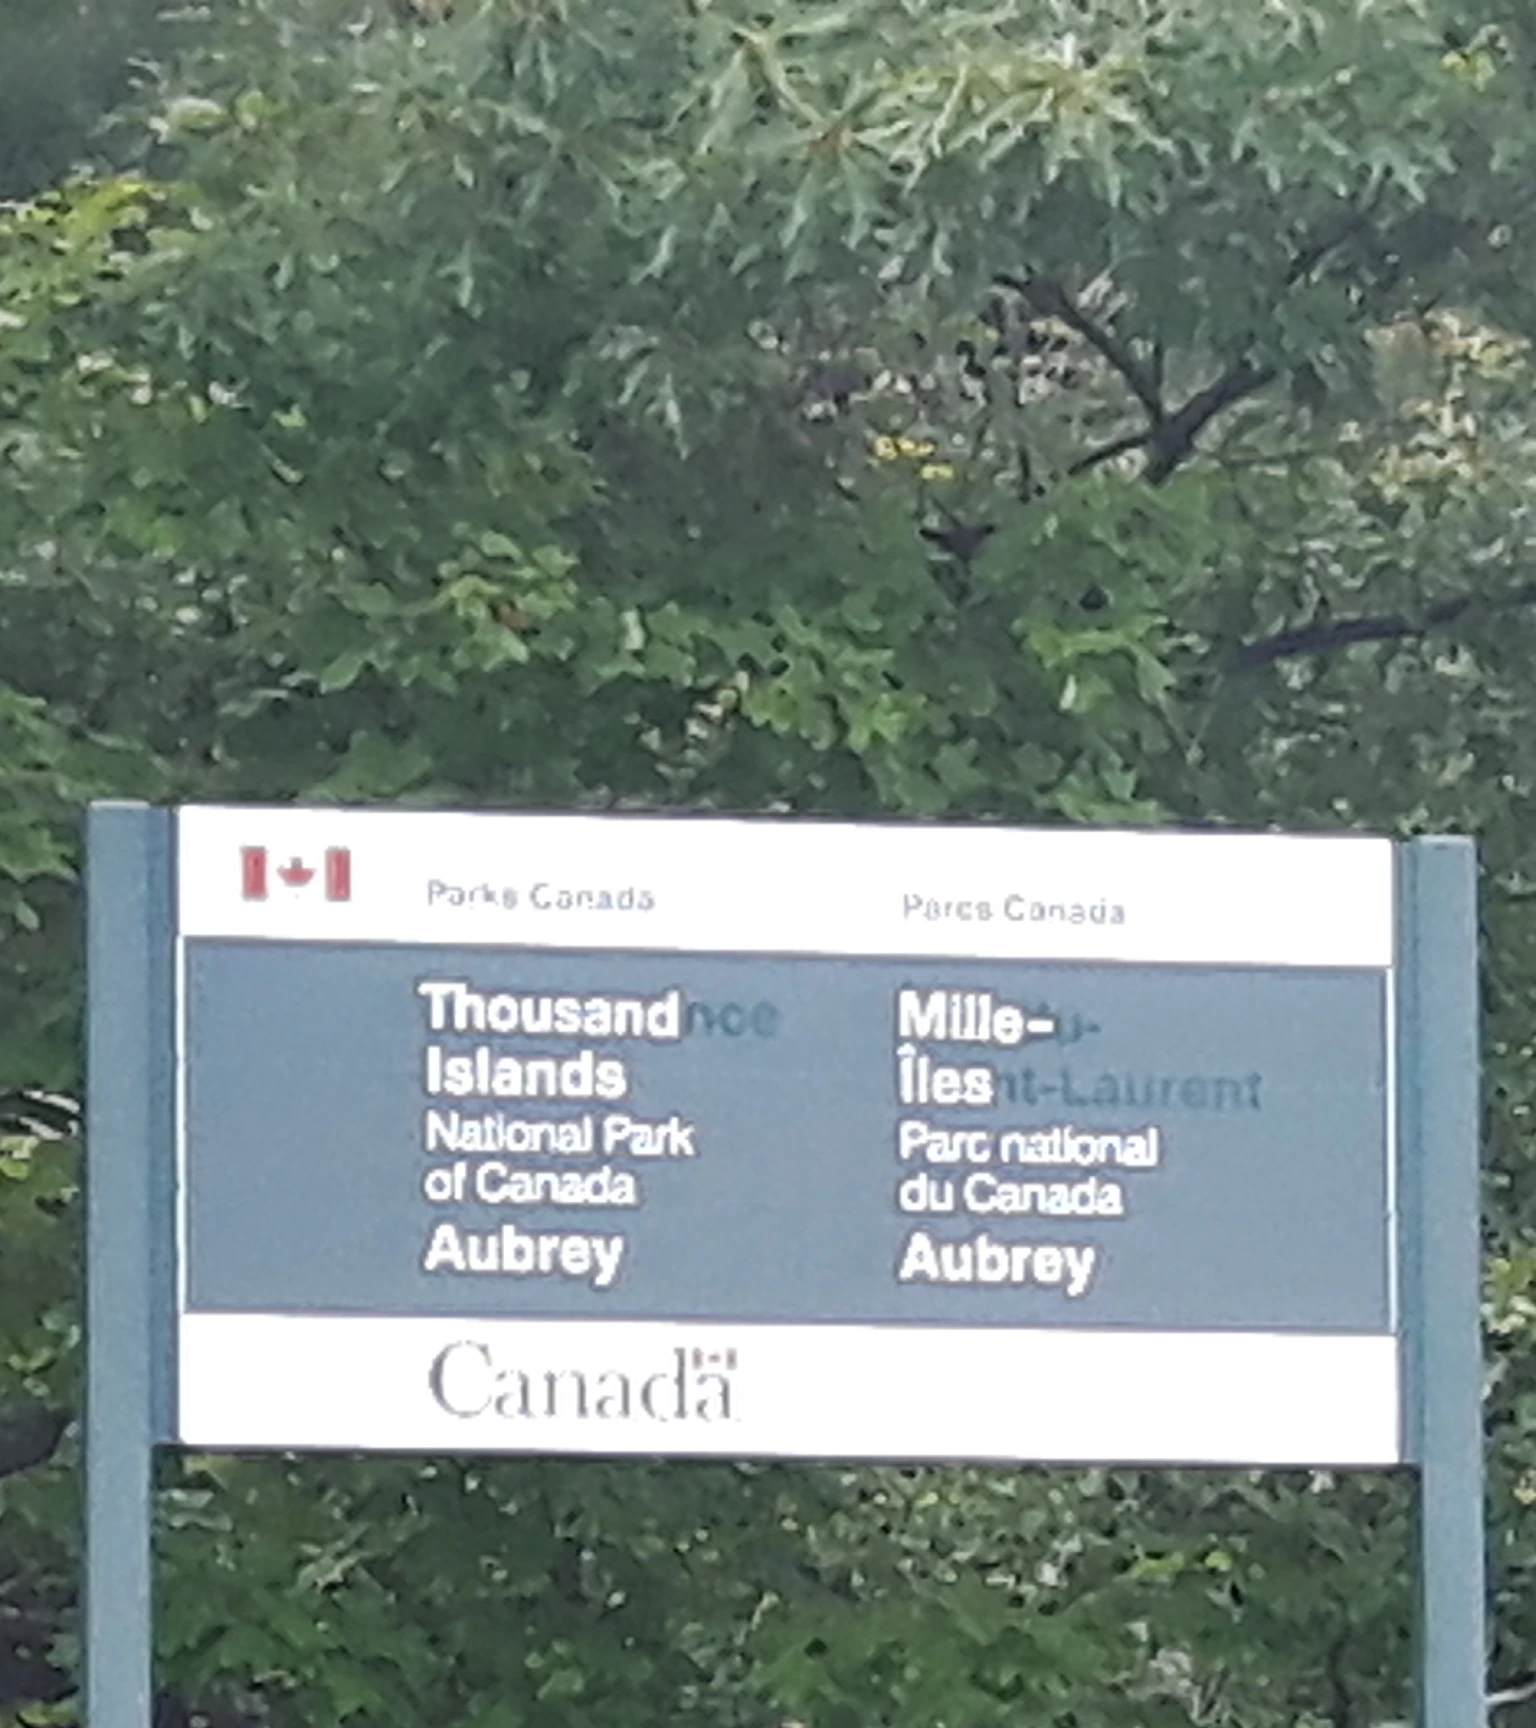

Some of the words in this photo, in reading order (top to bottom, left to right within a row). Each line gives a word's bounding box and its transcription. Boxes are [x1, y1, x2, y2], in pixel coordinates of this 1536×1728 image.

[427, 879, 519, 910] Parks
[529, 883, 656, 911] Canada
[903, 893, 993, 921] Parcs
[1004, 893, 1126, 925] Canada
[418, 982, 680, 1037] Thousand
[898, 990, 1054, 1044] Mille-
[427, 1046, 627, 1099] Islands
[898, 1043, 994, 1104] Îles
[427, 1111, 592, 1153] National
[603, 1115, 695, 1155] Park
[900, 1120, 991, 1163] Parc
[1000, 1126, 1158, 1167] national
[425, 1162, 467, 1200] of
[476, 1162, 636, 1204] Canada
[900, 1172, 954, 1211] du
[963, 1172, 1124, 1215] Canada
[424, 1224, 623, 1285] Aubrey
[900, 1232, 1095, 1296] Aubrey
[428, 1340, 737, 1423] Canada
